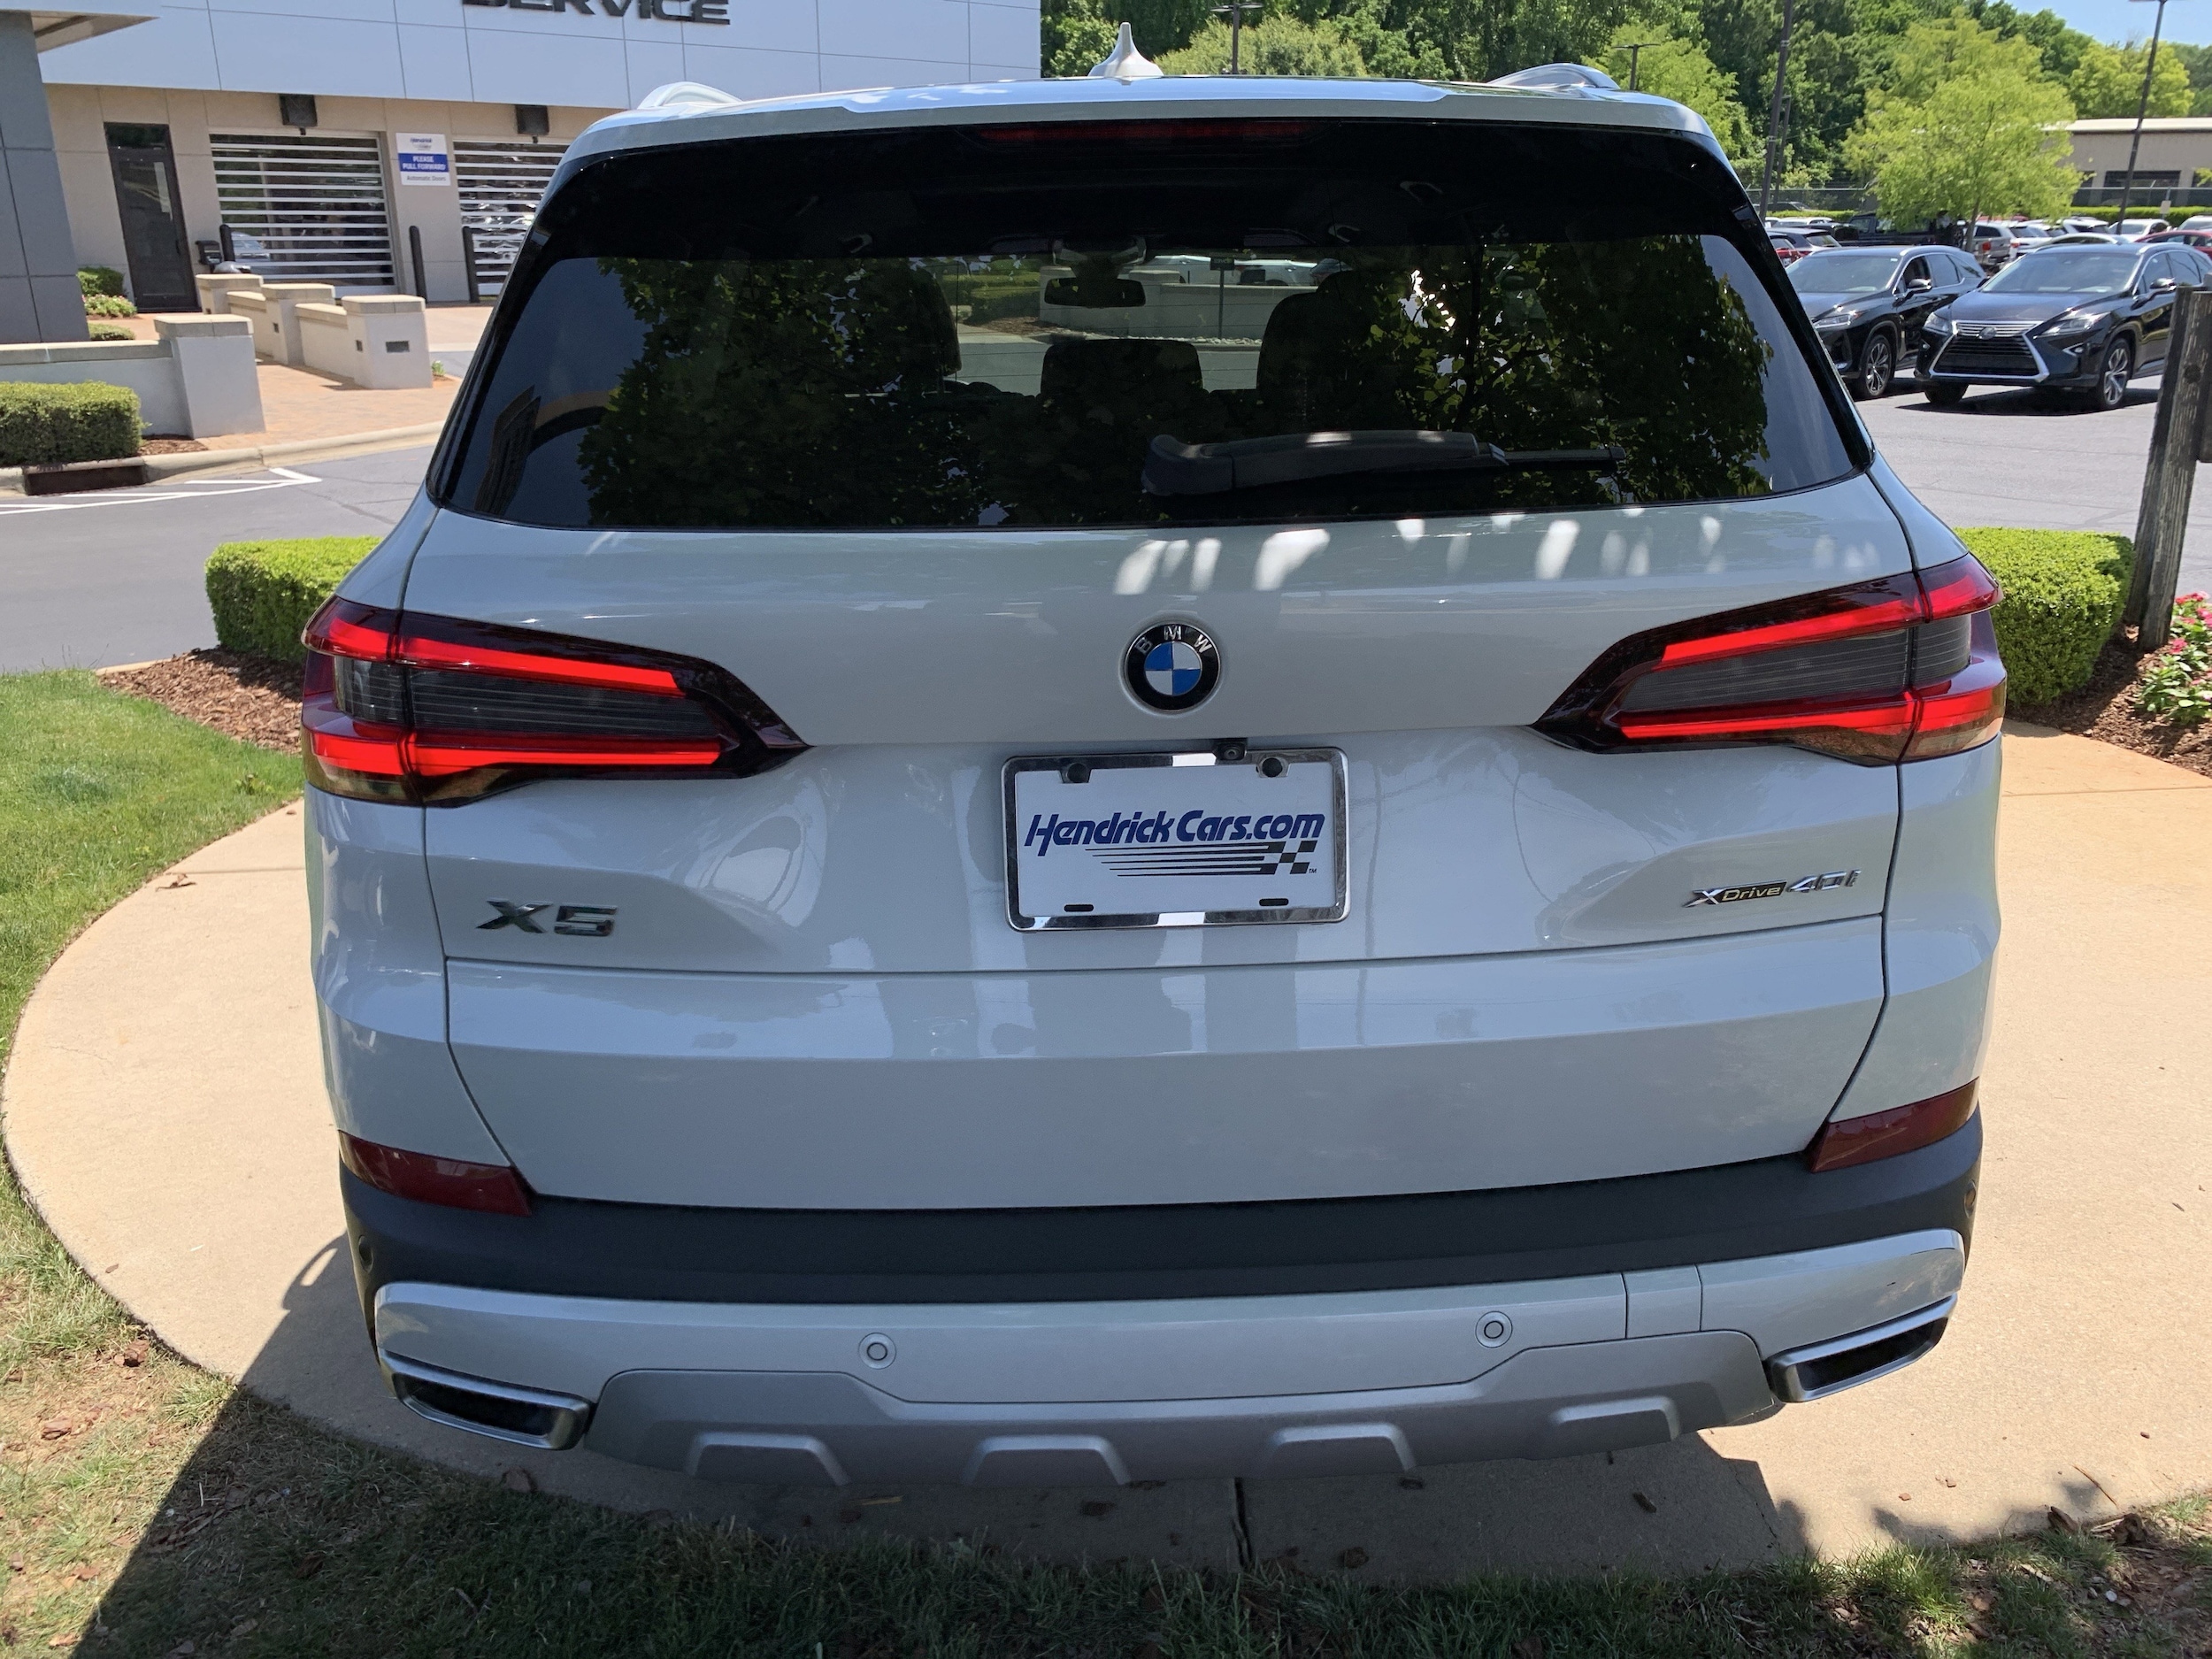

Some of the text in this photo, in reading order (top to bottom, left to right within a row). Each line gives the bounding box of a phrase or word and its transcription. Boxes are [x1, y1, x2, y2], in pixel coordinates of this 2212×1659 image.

[462, 0, 731, 25] RVICE
[1134, 625, 1212, 655] BMW
[475, 897, 618, 936] X5
